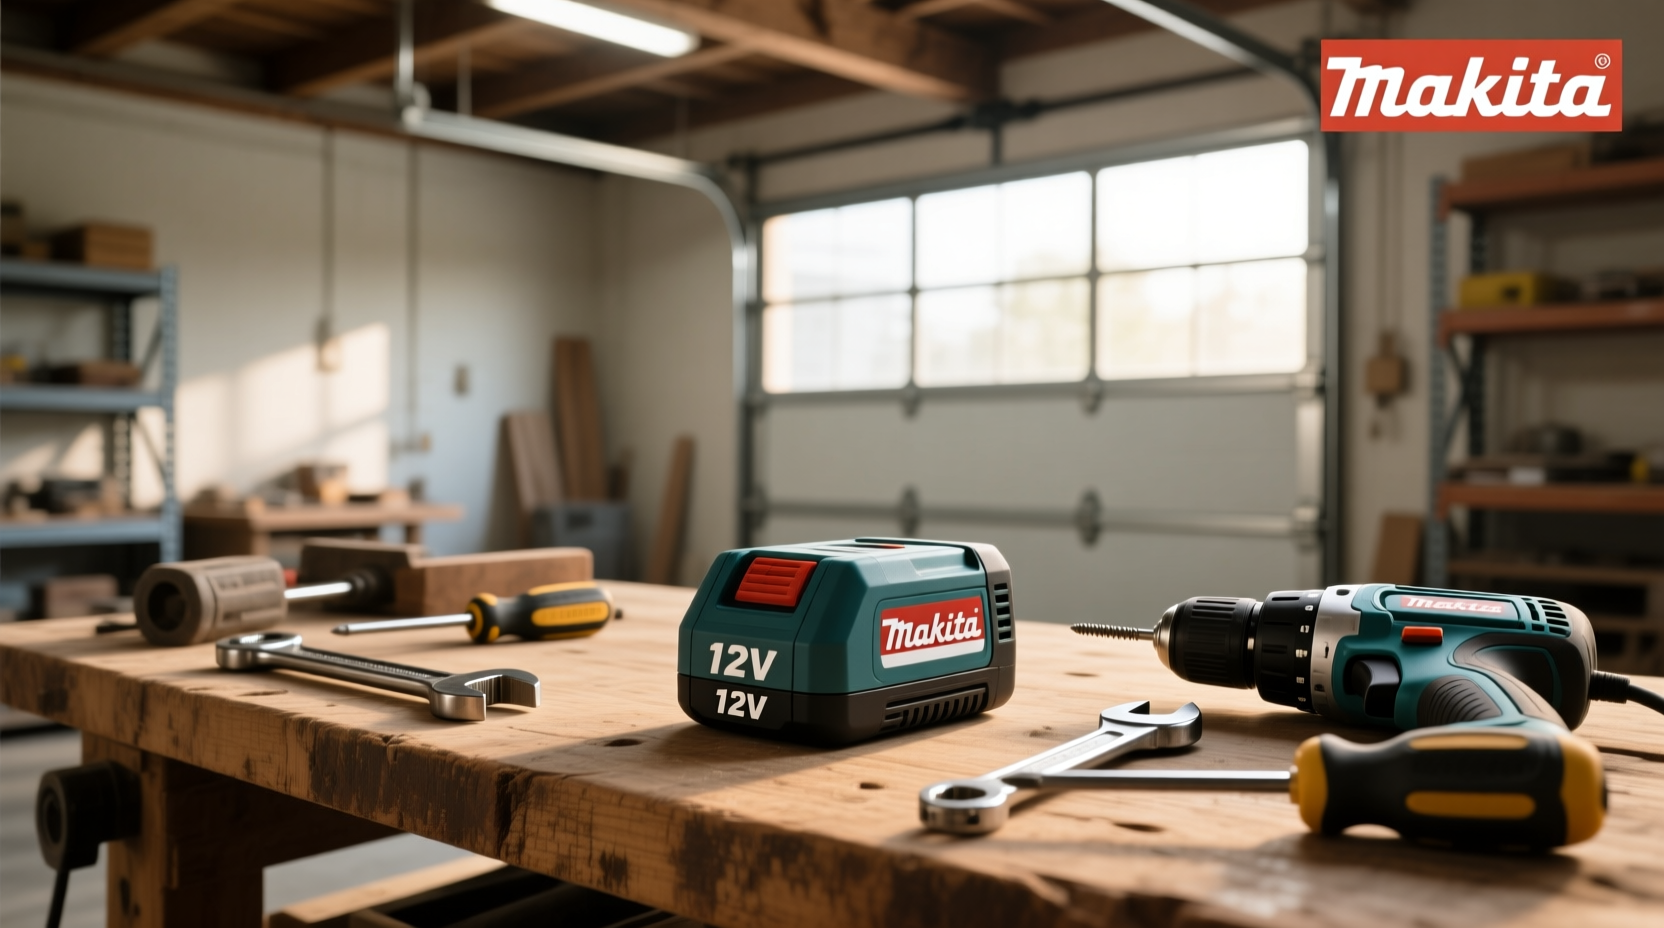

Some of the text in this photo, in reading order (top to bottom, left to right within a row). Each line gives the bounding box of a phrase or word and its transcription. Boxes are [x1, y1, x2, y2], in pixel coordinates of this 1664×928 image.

[882, 609, 982, 651] Makita
[709, 642, 778, 682] 12V
[715, 688, 768, 720] 12V
